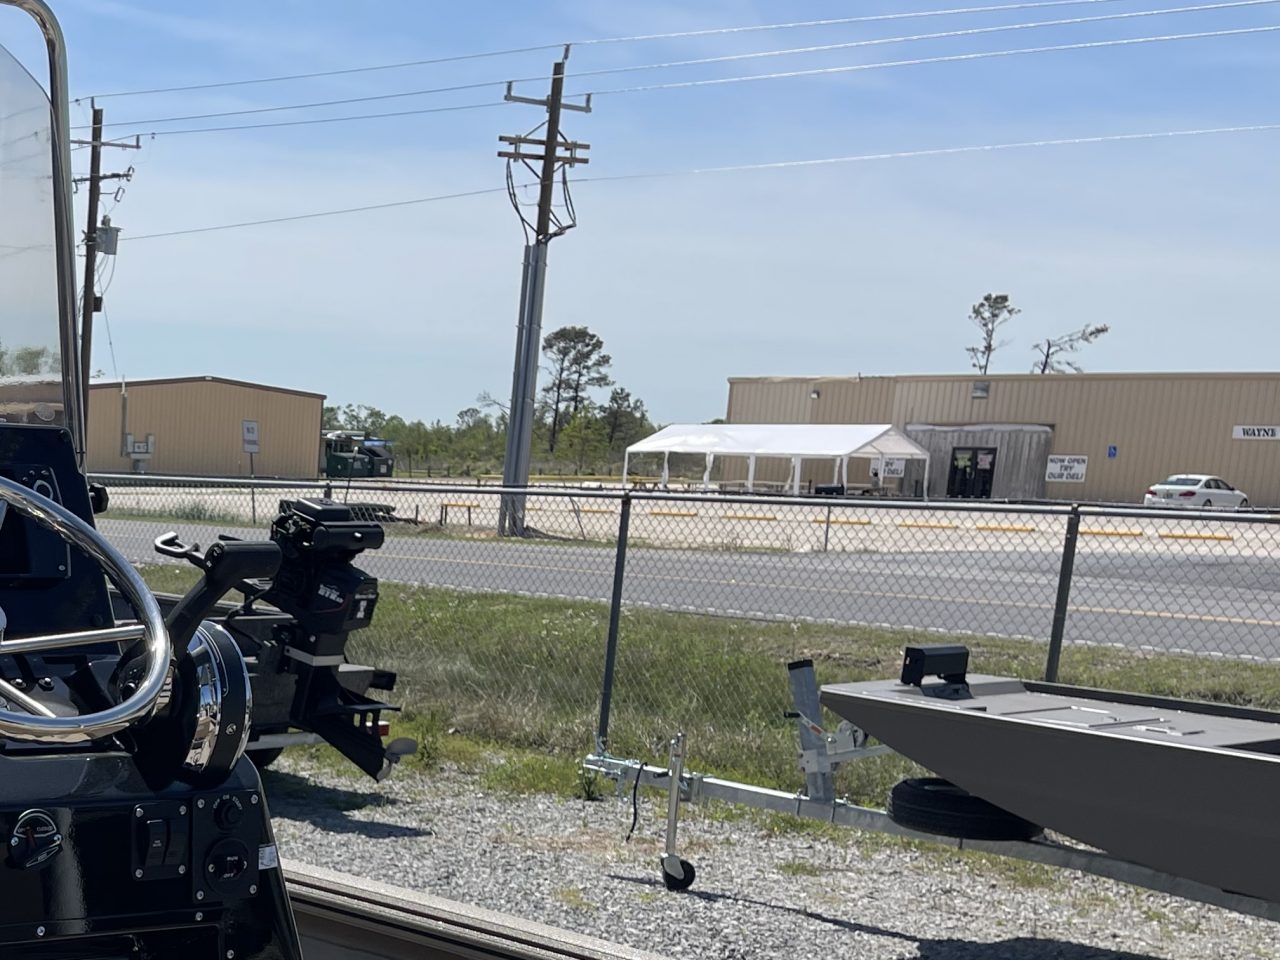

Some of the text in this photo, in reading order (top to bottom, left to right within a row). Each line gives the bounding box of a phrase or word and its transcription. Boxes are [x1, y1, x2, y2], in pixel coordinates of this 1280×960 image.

[1048, 457, 1087, 465] NOW OPEN
[1047, 472, 1084, 480] OUR DELI
